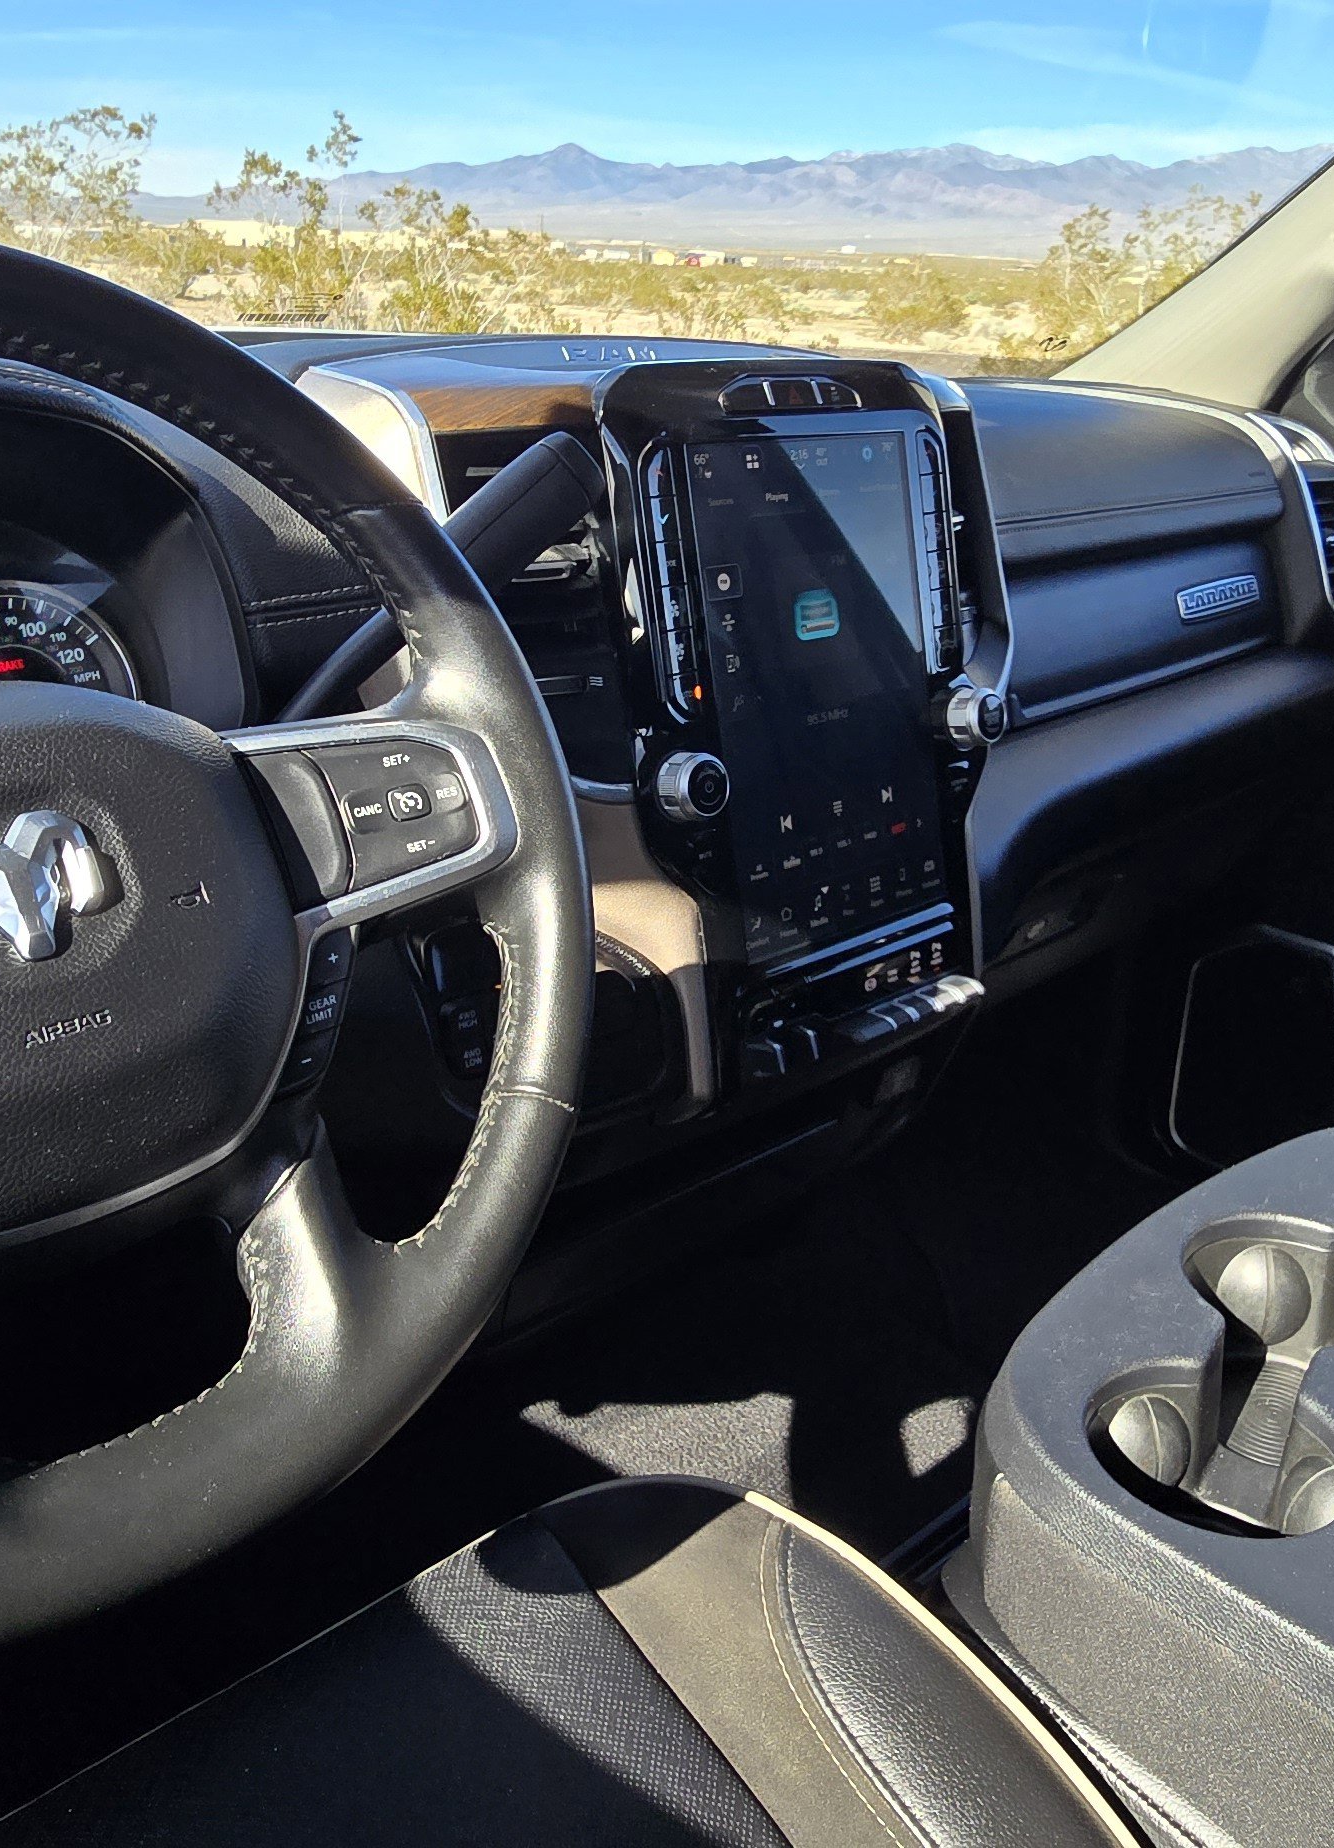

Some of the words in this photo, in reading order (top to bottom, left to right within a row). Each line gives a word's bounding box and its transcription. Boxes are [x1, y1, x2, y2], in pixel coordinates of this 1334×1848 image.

[764, 491, 790, 503] Playing
[1182, 581, 1257, 611] LARAMIE
[4, 616, 18, 627] 90
[18, 620, 47, 638] 100
[49, 632, 67, 644] 110
[56, 648, 85, 666] 120
[73, 670, 102, 685] MPH
[435, 786, 459, 801] RES
[353, 802, 383, 818] CANC
[308, 994, 337, 1012] GEAR
[305, 1008, 334, 1026] LIMIT
[25, 1008, 113, 1049] AIRBAG
[464, 1056, 483, 1069] LOW
